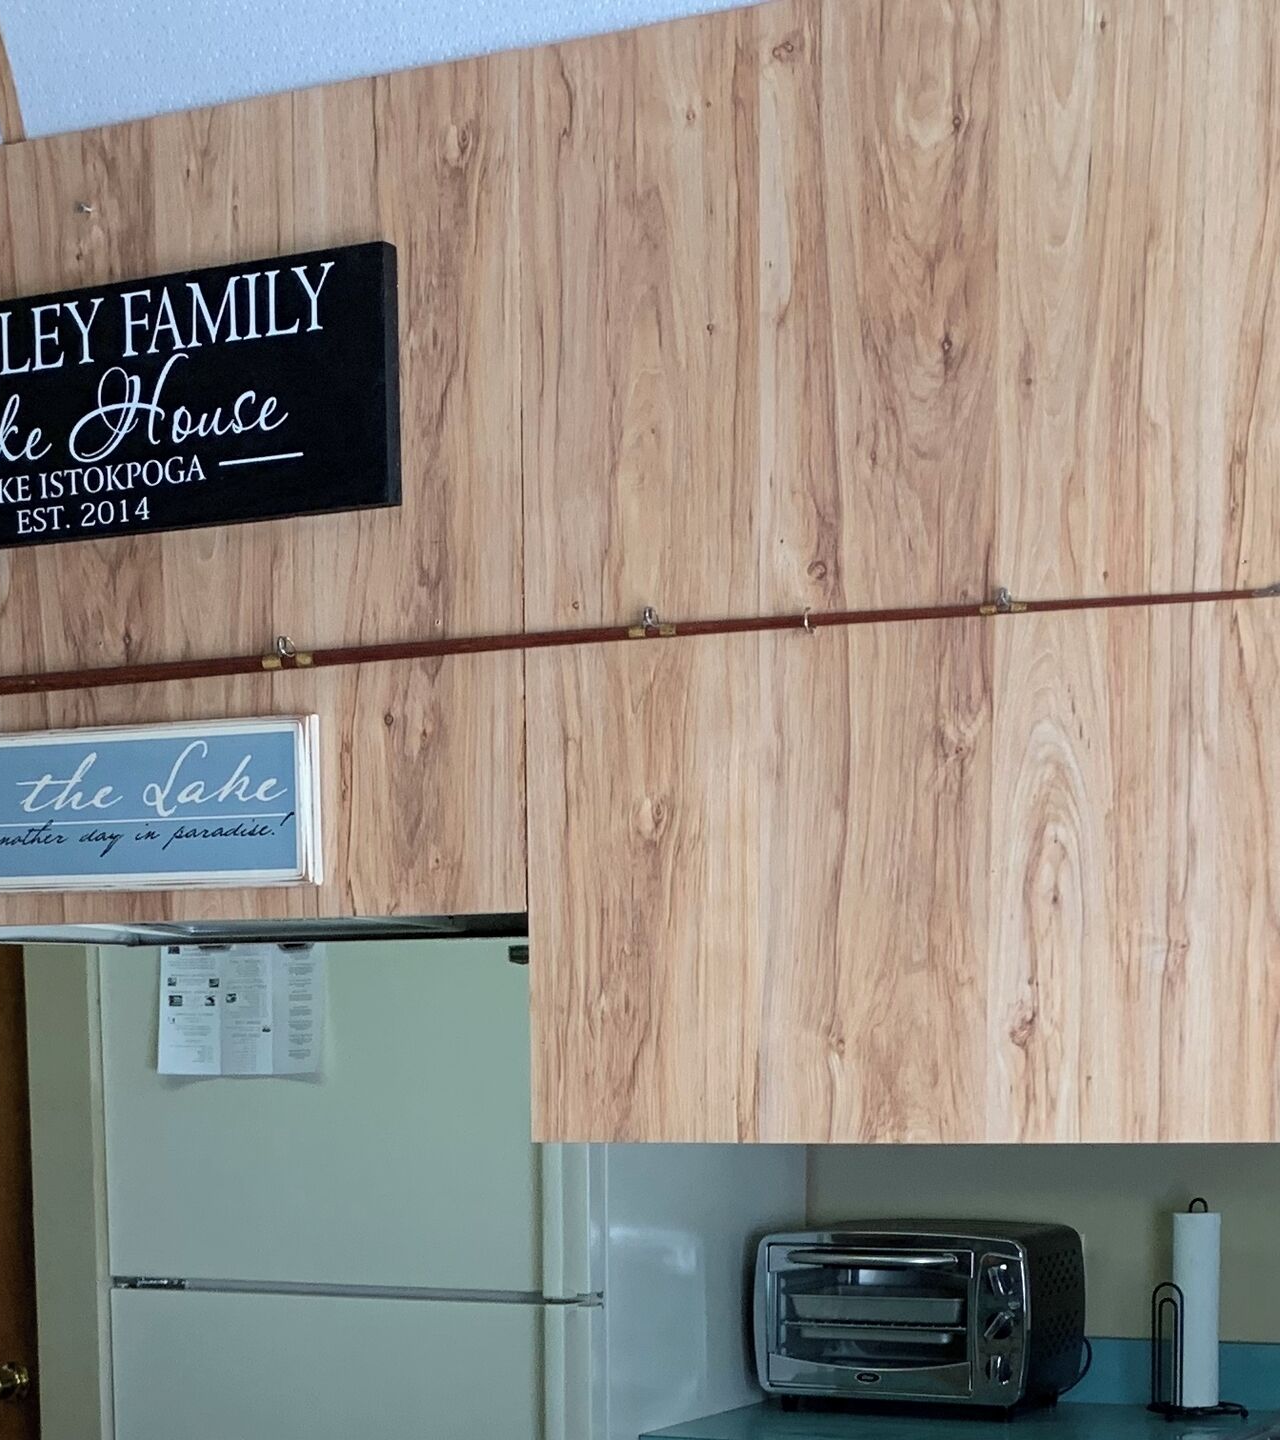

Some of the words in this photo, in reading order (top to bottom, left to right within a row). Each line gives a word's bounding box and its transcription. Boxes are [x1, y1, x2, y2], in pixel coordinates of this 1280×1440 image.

[121, 262, 336, 357] FAMILY
[69, 353, 289, 462] House
[39, 455, 206, 500] ISTOKPOGA
[17, 504, 70, 535] EST.
[80, 497, 150, 527] 2014
[16, 751, 123, 813] the
[142, 739, 288, 818] Lake
[79, 827, 121, 858] day
[135, 822, 161, 842] in
[162, 811, 295, 850] paradise!
